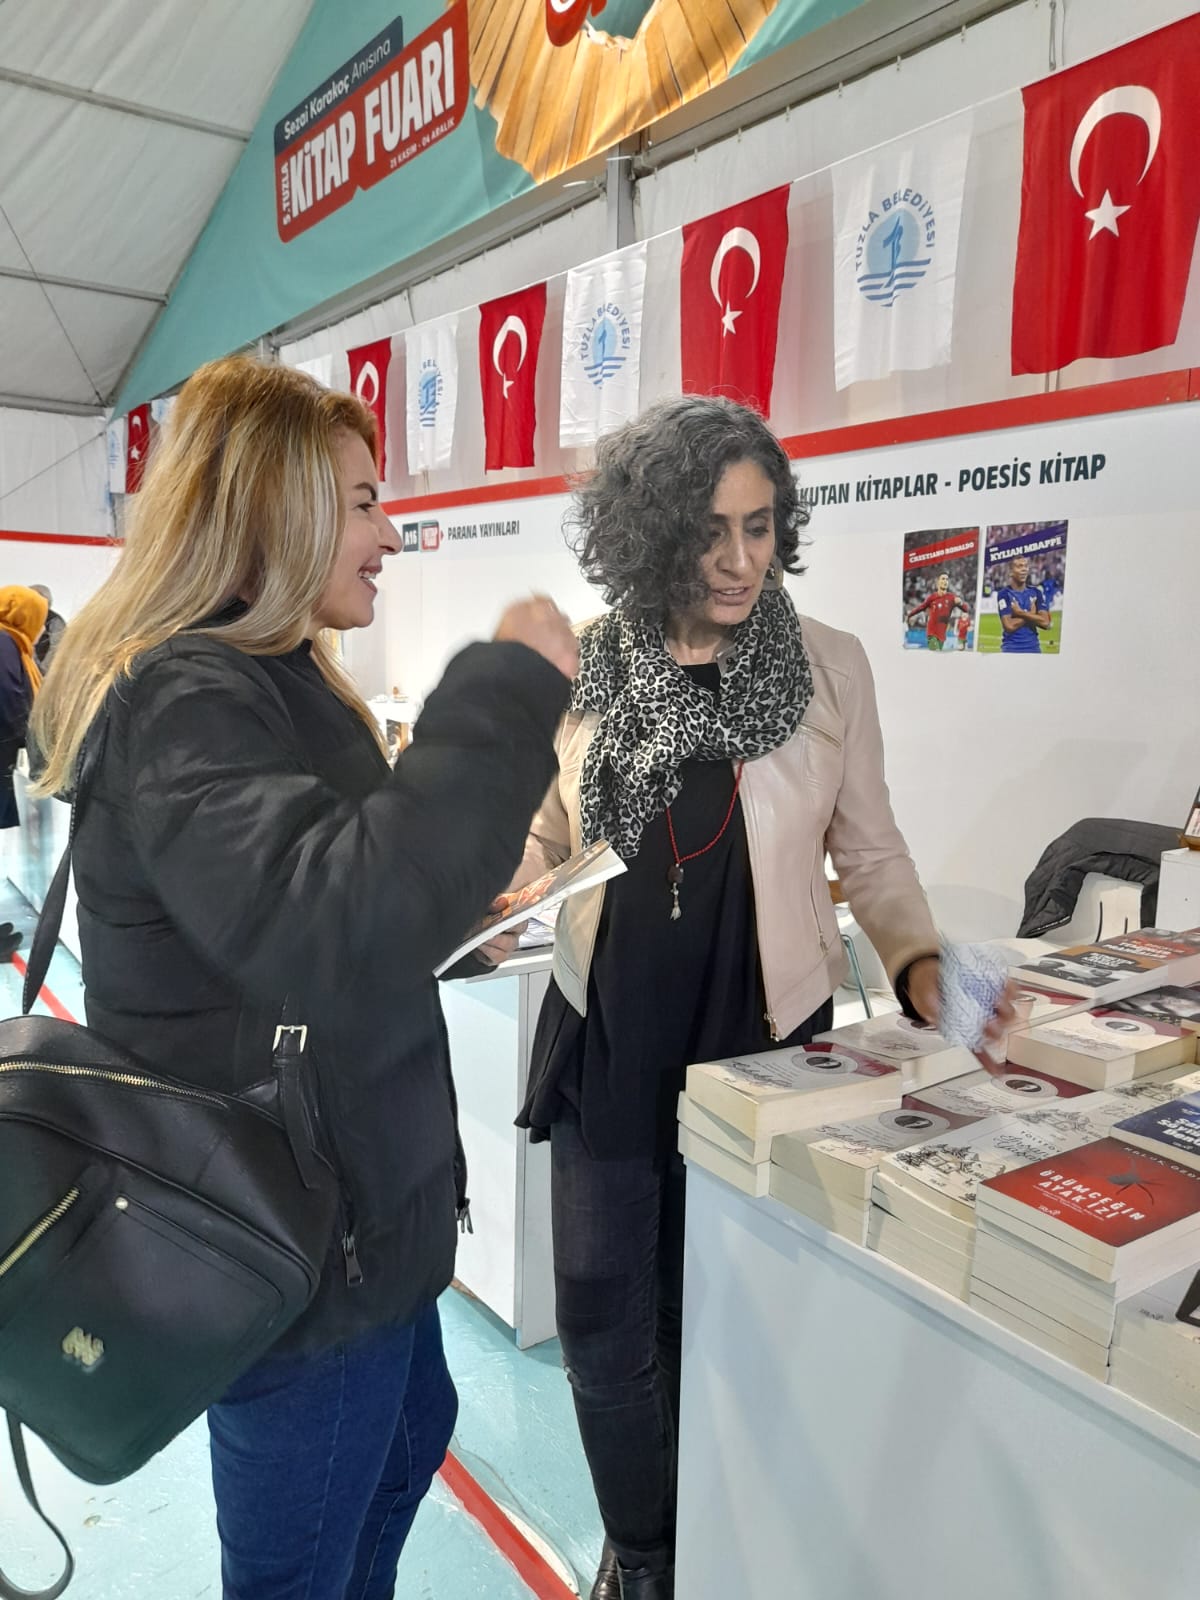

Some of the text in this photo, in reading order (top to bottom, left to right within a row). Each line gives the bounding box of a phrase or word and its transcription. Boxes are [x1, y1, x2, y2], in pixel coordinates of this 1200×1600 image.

[284, 39, 391, 140] Sezai Karakoç Anısına
[289, 26, 455, 218] KİTAP FUARI
[855, 210, 880, 272] TUZLA
[856, 472, 938, 502] KİTAPLAR
[958, 457, 1031, 492] POESİS
[1039, 452, 1106, 484] KİTAP
[448, 524, 478, 540] PARANA
[480, 520, 520, 537] YAYINLARI
[990, 546, 1023, 561] KYLIAN
[1038, 1181, 1087, 1203] AYAK
[1040, 1169, 1145, 1220] ÖRÜMCEĞİN
